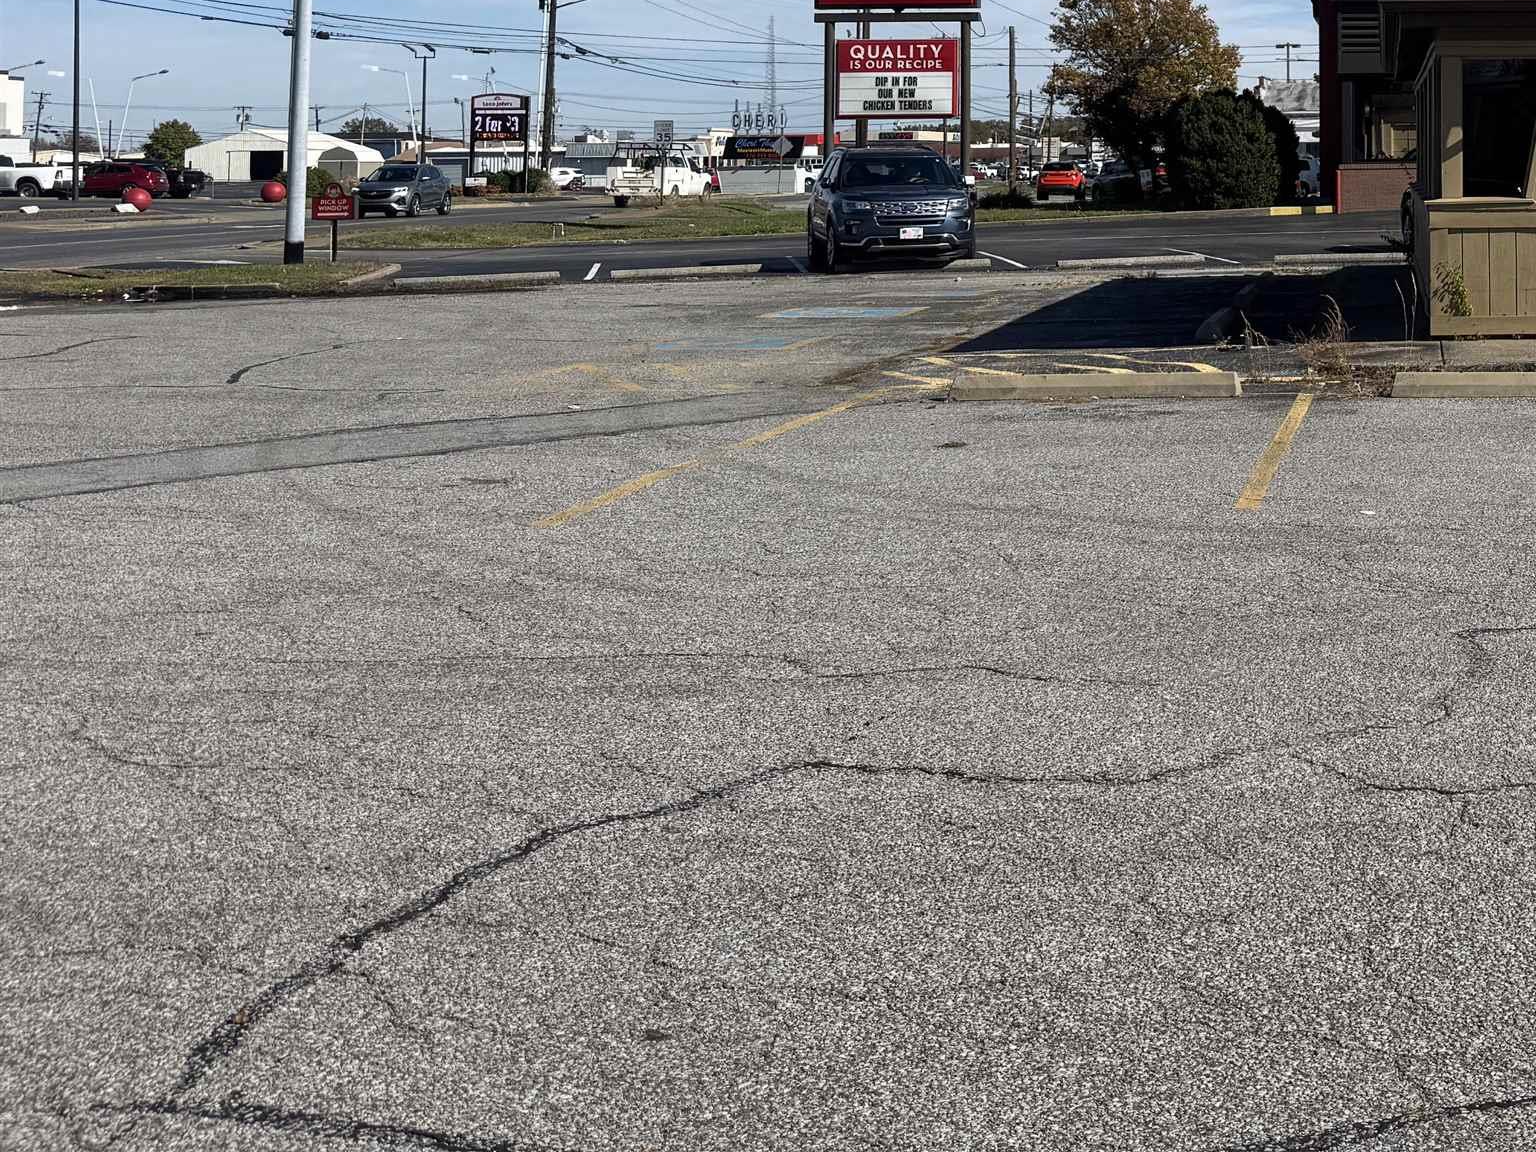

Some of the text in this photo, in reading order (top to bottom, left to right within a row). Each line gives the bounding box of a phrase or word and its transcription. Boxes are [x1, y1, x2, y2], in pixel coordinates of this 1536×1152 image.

[849, 44, 943, 59] QUALITY
[849, 60, 943, 69] IS OUR RECIPE
[875, 76, 918, 87] DIP IN FOR
[877, 88, 916, 98] OUR NEW
[863, 100, 932, 110] CHICKEN TENDERS
[474, 116, 482, 132] 2
[732, 112, 784, 128] CHERI
[656, 132, 671, 142] 35
